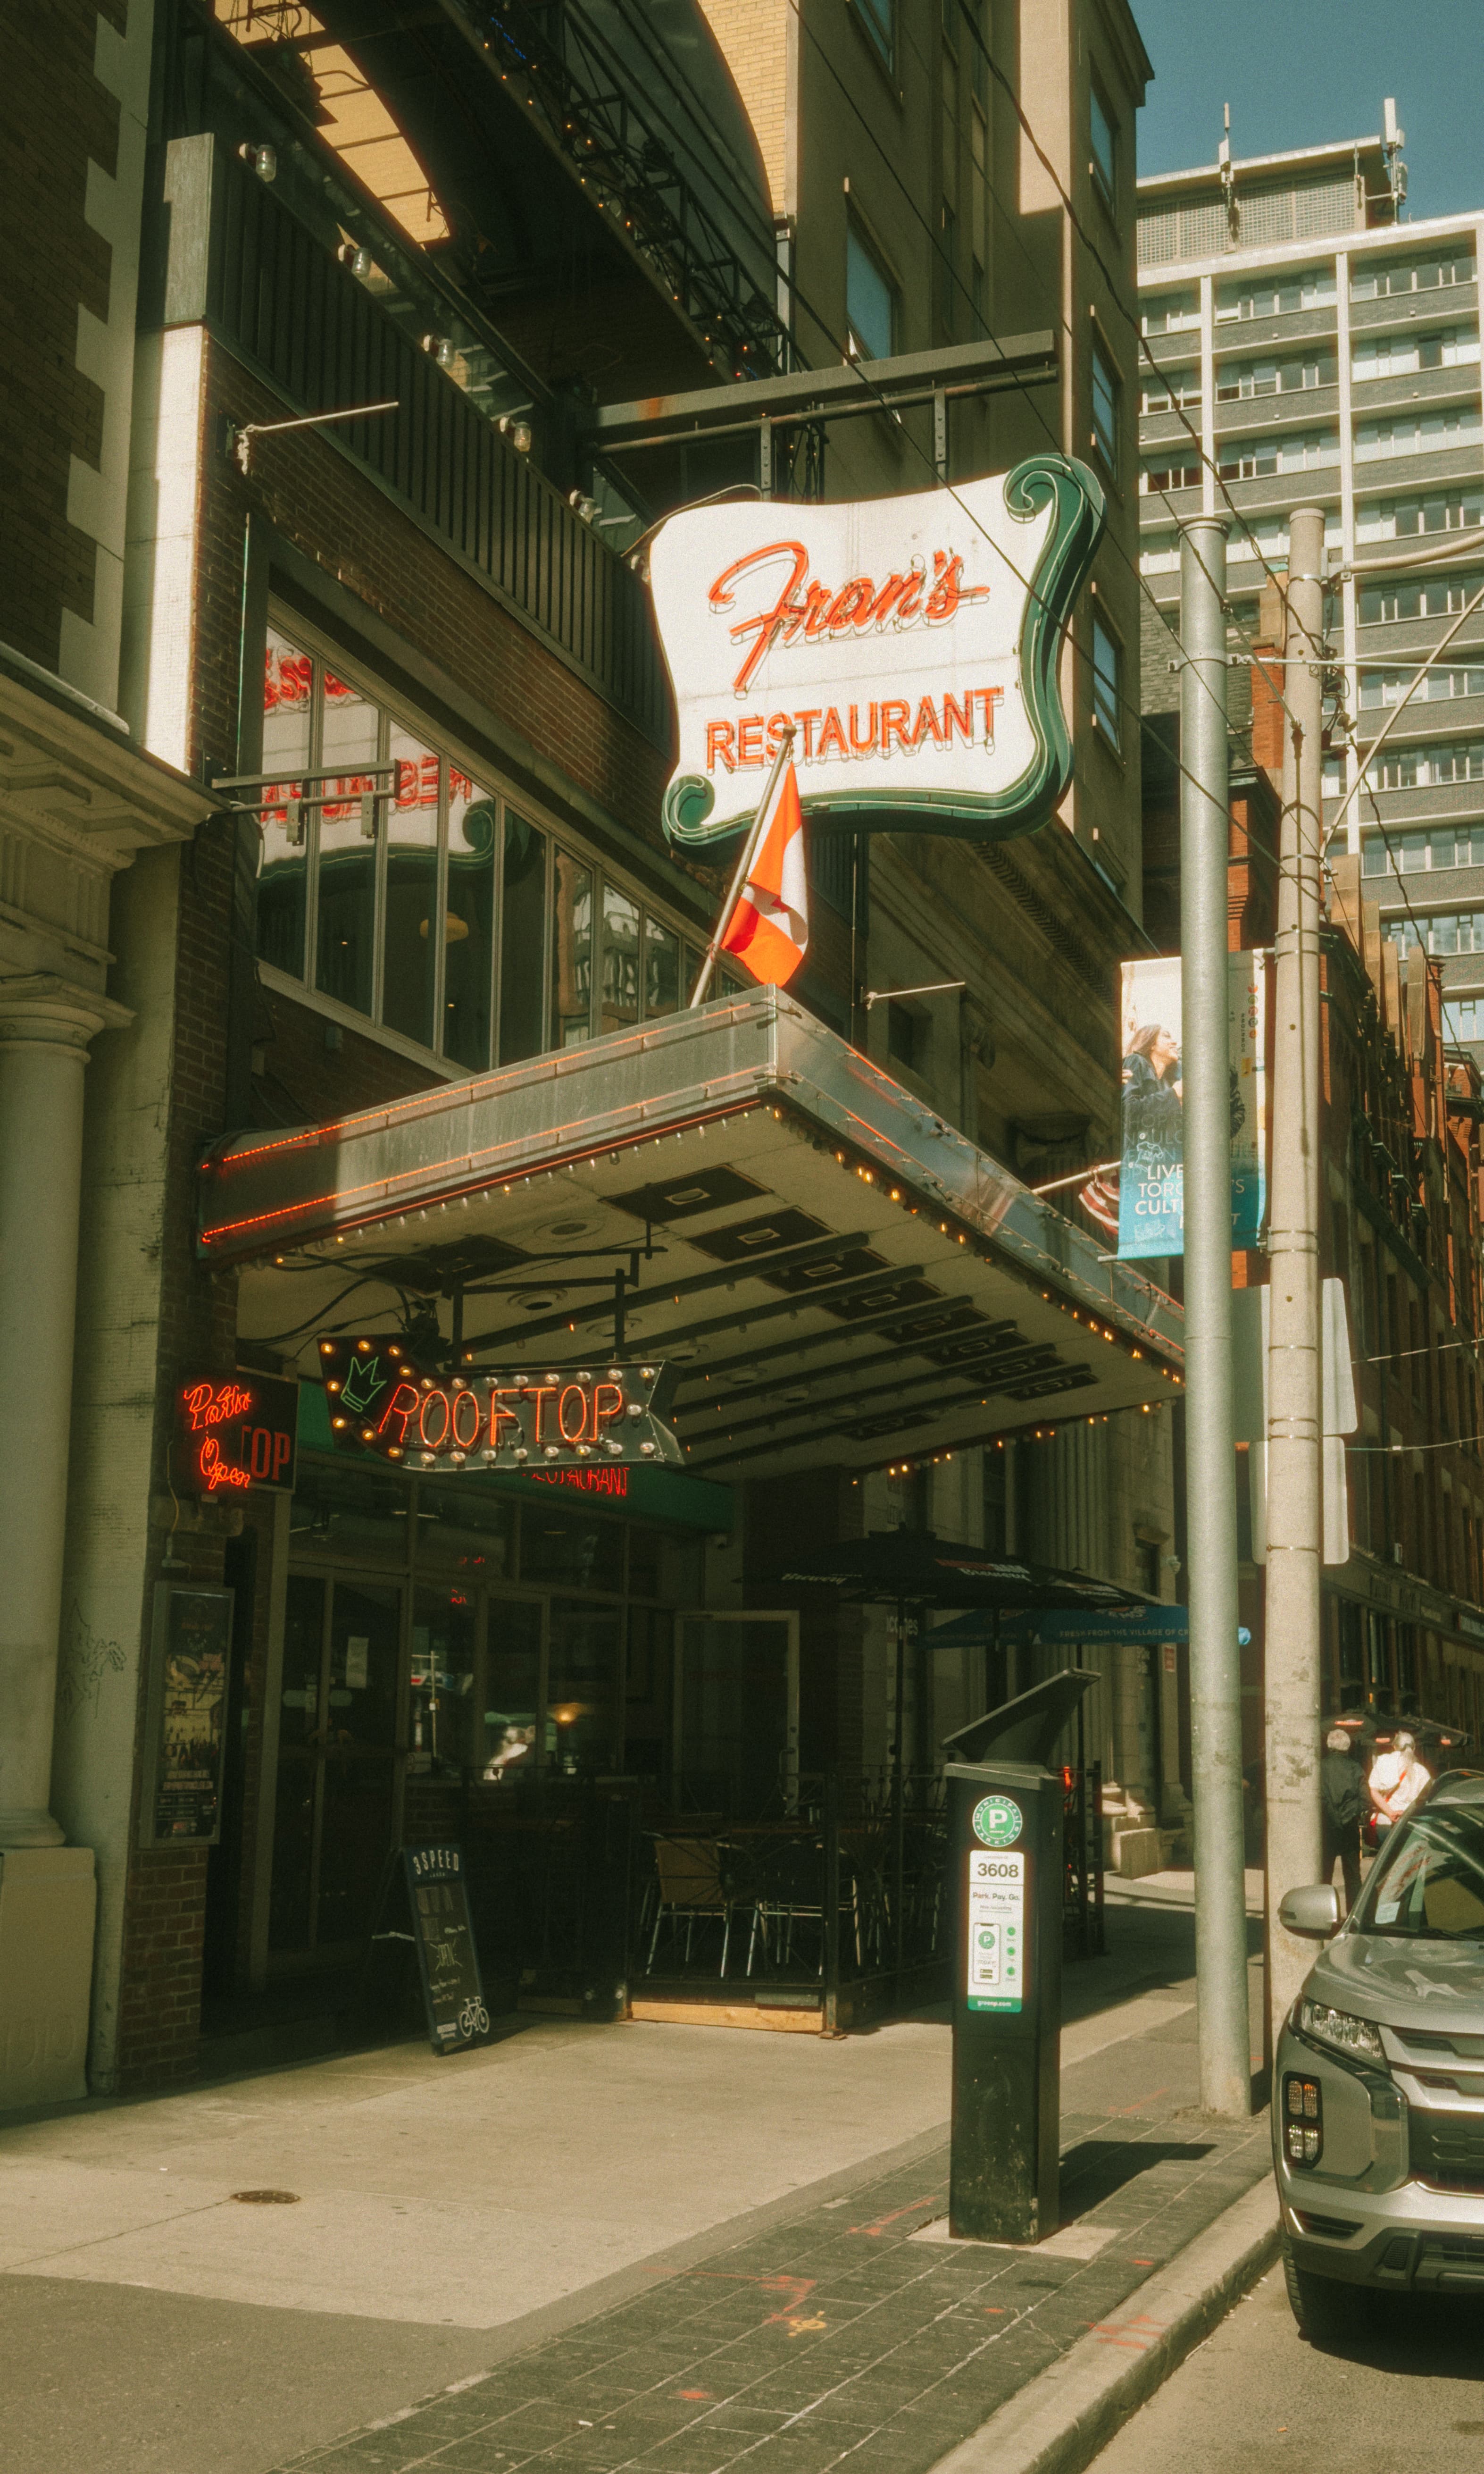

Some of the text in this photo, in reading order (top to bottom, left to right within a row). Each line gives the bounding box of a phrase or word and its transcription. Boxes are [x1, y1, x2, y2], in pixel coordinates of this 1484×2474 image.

[709, 540, 992, 698] Fran's
[706, 685, 1005, 774] RESTAURANT
[183, 1384, 252, 1430] Patio
[378, 1383, 623, 1448] ROOFTOP
[200, 1437, 250, 1490] Open
[976, 1798, 1019, 1820] MUNICIPAL
[989, 1809, 1008, 1828] P
[976, 1825, 1019, 1845] PARKING
[977, 1863, 1019, 1878] 3608
[992, 1893, 1007, 1901] Pay.
